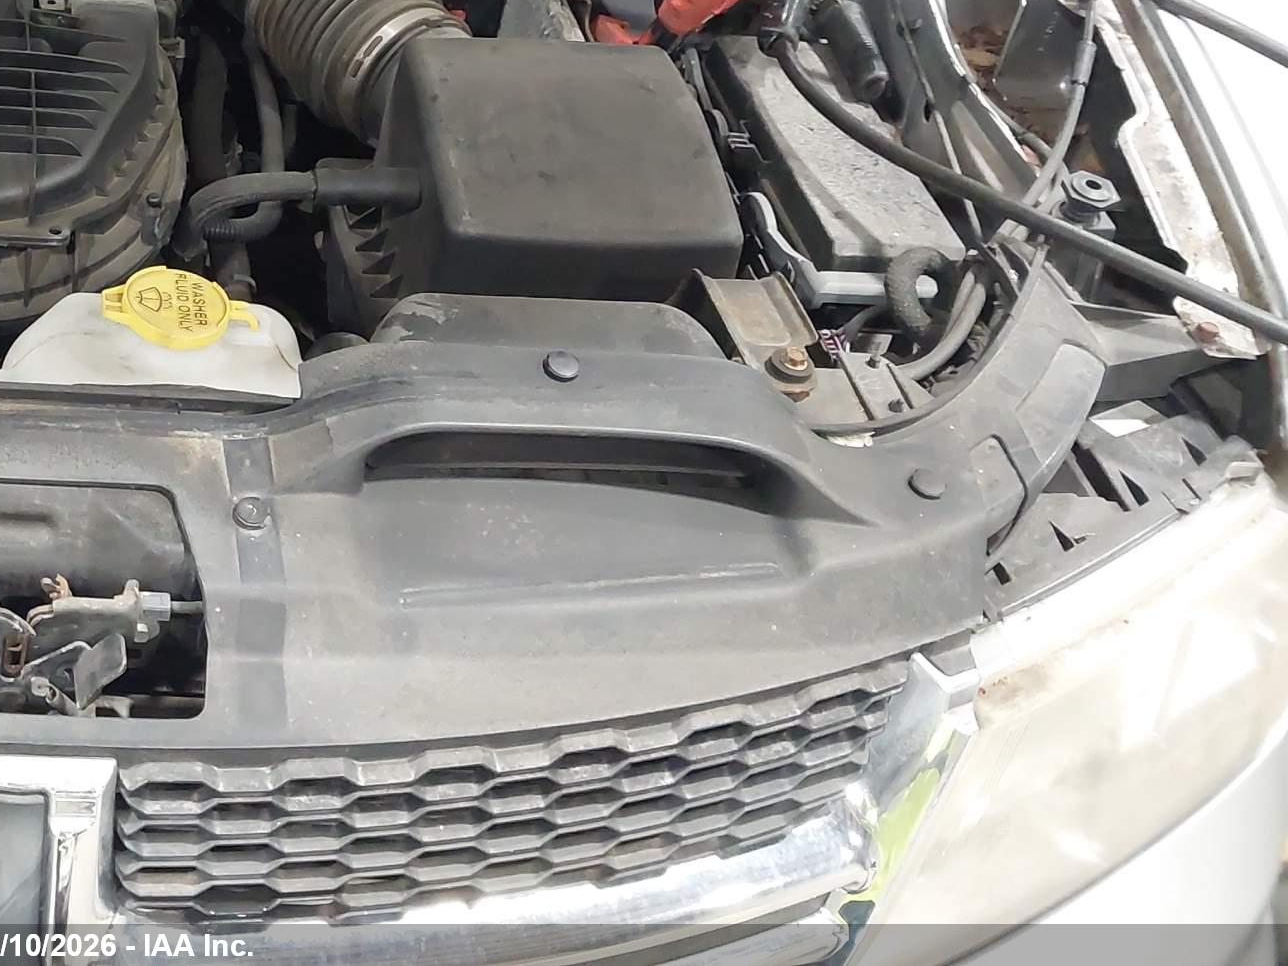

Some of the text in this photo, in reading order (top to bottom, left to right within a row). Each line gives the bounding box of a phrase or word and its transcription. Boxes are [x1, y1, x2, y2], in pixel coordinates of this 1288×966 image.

[175, 273, 193, 332] FLUID ONLY
[192, 282, 208, 326] WASHER
